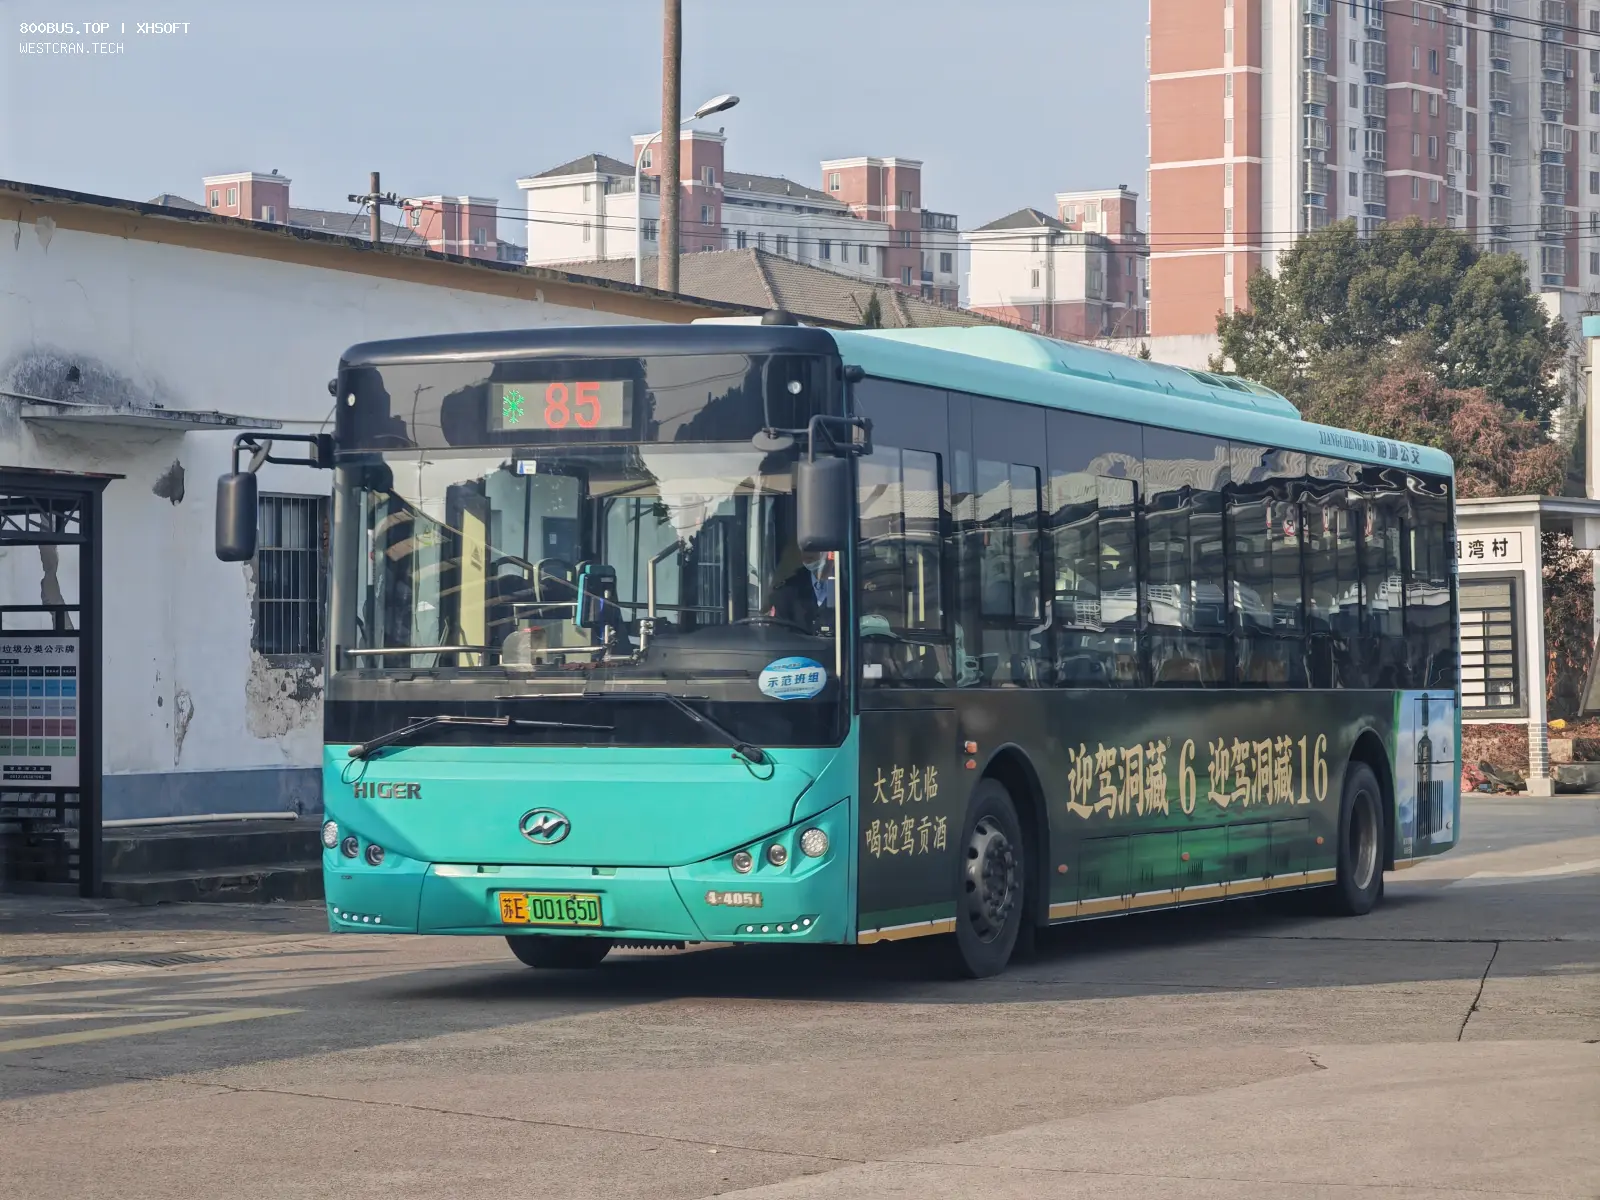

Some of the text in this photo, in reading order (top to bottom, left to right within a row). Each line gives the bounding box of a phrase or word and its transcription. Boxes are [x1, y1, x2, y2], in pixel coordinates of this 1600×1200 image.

[544, 381, 602, 429] 85
[1362, 438, 1375, 454] BUS
[0, 644, 75, 654] 垃圾分类公示牌
[767, 671, 819, 688] 示范班组
[353, 782, 422, 800] HIGER
[872, 764, 938, 806] 大驾光临
[865, 814, 948, 859] 喝迎驾贡酒
